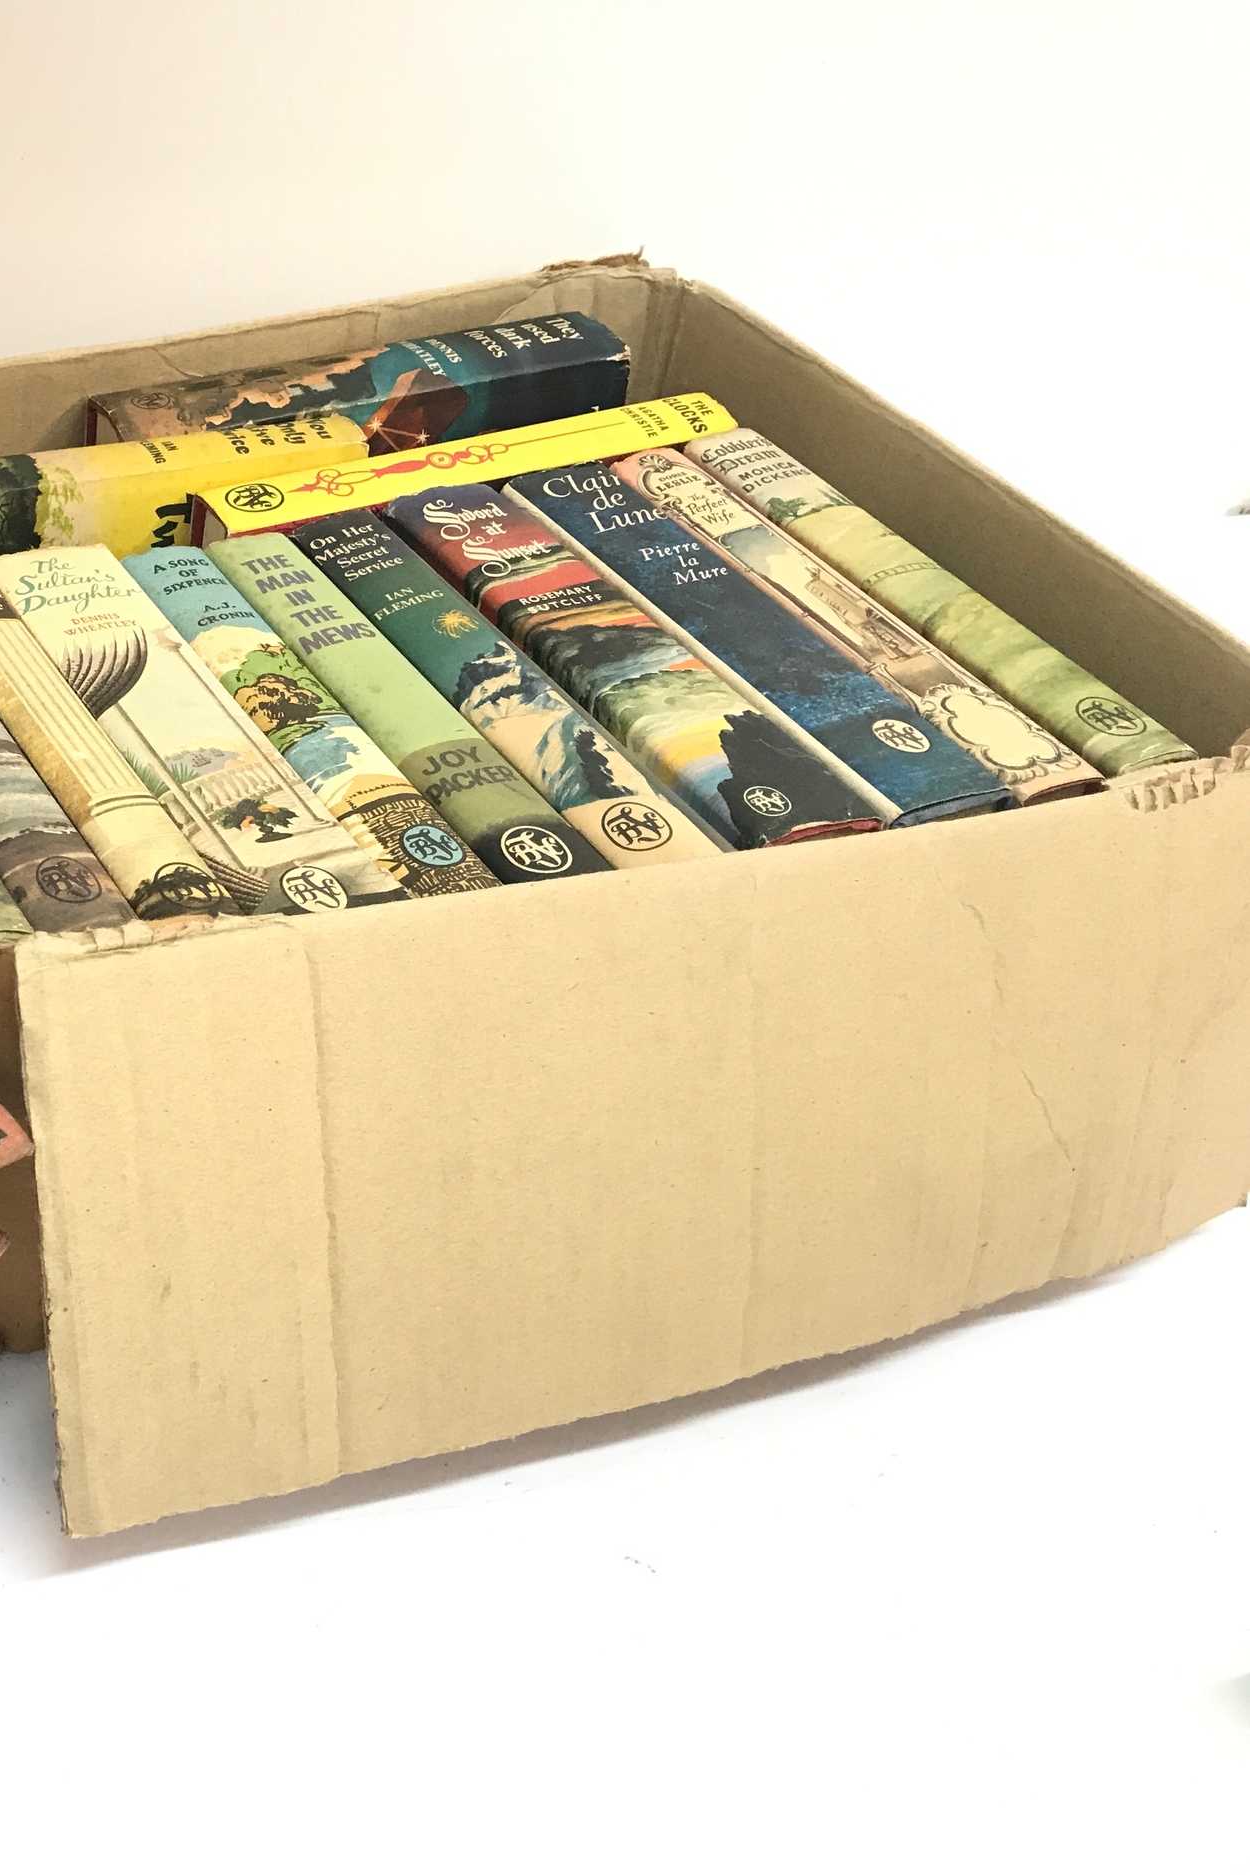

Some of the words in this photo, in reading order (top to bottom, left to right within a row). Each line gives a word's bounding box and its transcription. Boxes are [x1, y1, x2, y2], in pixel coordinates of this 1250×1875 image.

[495, 327, 532, 350] dark
[521, 323, 560, 344] used
[546, 317, 583, 340] They
[464, 330, 508, 358] forces
[638, 406, 669, 431] AGATHA
[662, 397, 708, 434] CLOCKS
[691, 400, 714, 417] THE
[620, 407, 658, 438] CHRISTIE
[700, 436, 772, 463] Cobbler's
[713, 450, 781, 475] Dream
[738, 461, 797, 481] MONICA
[543, 470, 620, 498] Clair
[656, 475, 701, 492] LESLIE
[658, 472, 685, 483] DORIS
[742, 469, 811, 493] DICKENS
[593, 488, 626, 511] de
[687, 498, 728, 515] Perfect
[688, 492, 706, 502] The
[423, 499, 507, 540] Sword
[481, 521, 507, 538] at
[585, 508, 668, 534] Lune
[702, 511, 736, 525] Wife
[310, 535, 336, 550] On
[341, 523, 374, 540] Her
[314, 533, 392, 566] Majesty's
[337, 546, 389, 569] Secret
[462, 535, 551, 577] Sunset
[639, 541, 700, 561] Pierre
[30, 557, 75, 574] The
[154, 564, 167, 574] A
[168, 559, 209, 568] SONG
[178, 569, 198, 577] OF
[241, 554, 294, 575] THE
[344, 556, 404, 582] Service
[678, 556, 699, 568] la
[15, 568, 115, 596] Sultan's
[163, 578, 228, 595] SIXPENCE
[255, 569, 315, 594] MAN
[673, 566, 728, 585] Mure
[16, 584, 142, 615] Daughter
[284, 589, 316, 607] IN
[373, 589, 444, 621] FLEMING
[385, 586, 414, 602] IAN
[519, 584, 593, 605] ROSEMARY
[528, 594, 602, 614] SUTCLIFF
[63, 619, 138, 636] WHEATLEY
[71, 612, 120, 626] DENNIS
[197, 611, 255, 627] CRONIN
[289, 605, 344, 628] THE
[298, 623, 376, 655] MEWS
[422, 746, 482, 776] JOY
[425, 765, 520, 806] PACKER
